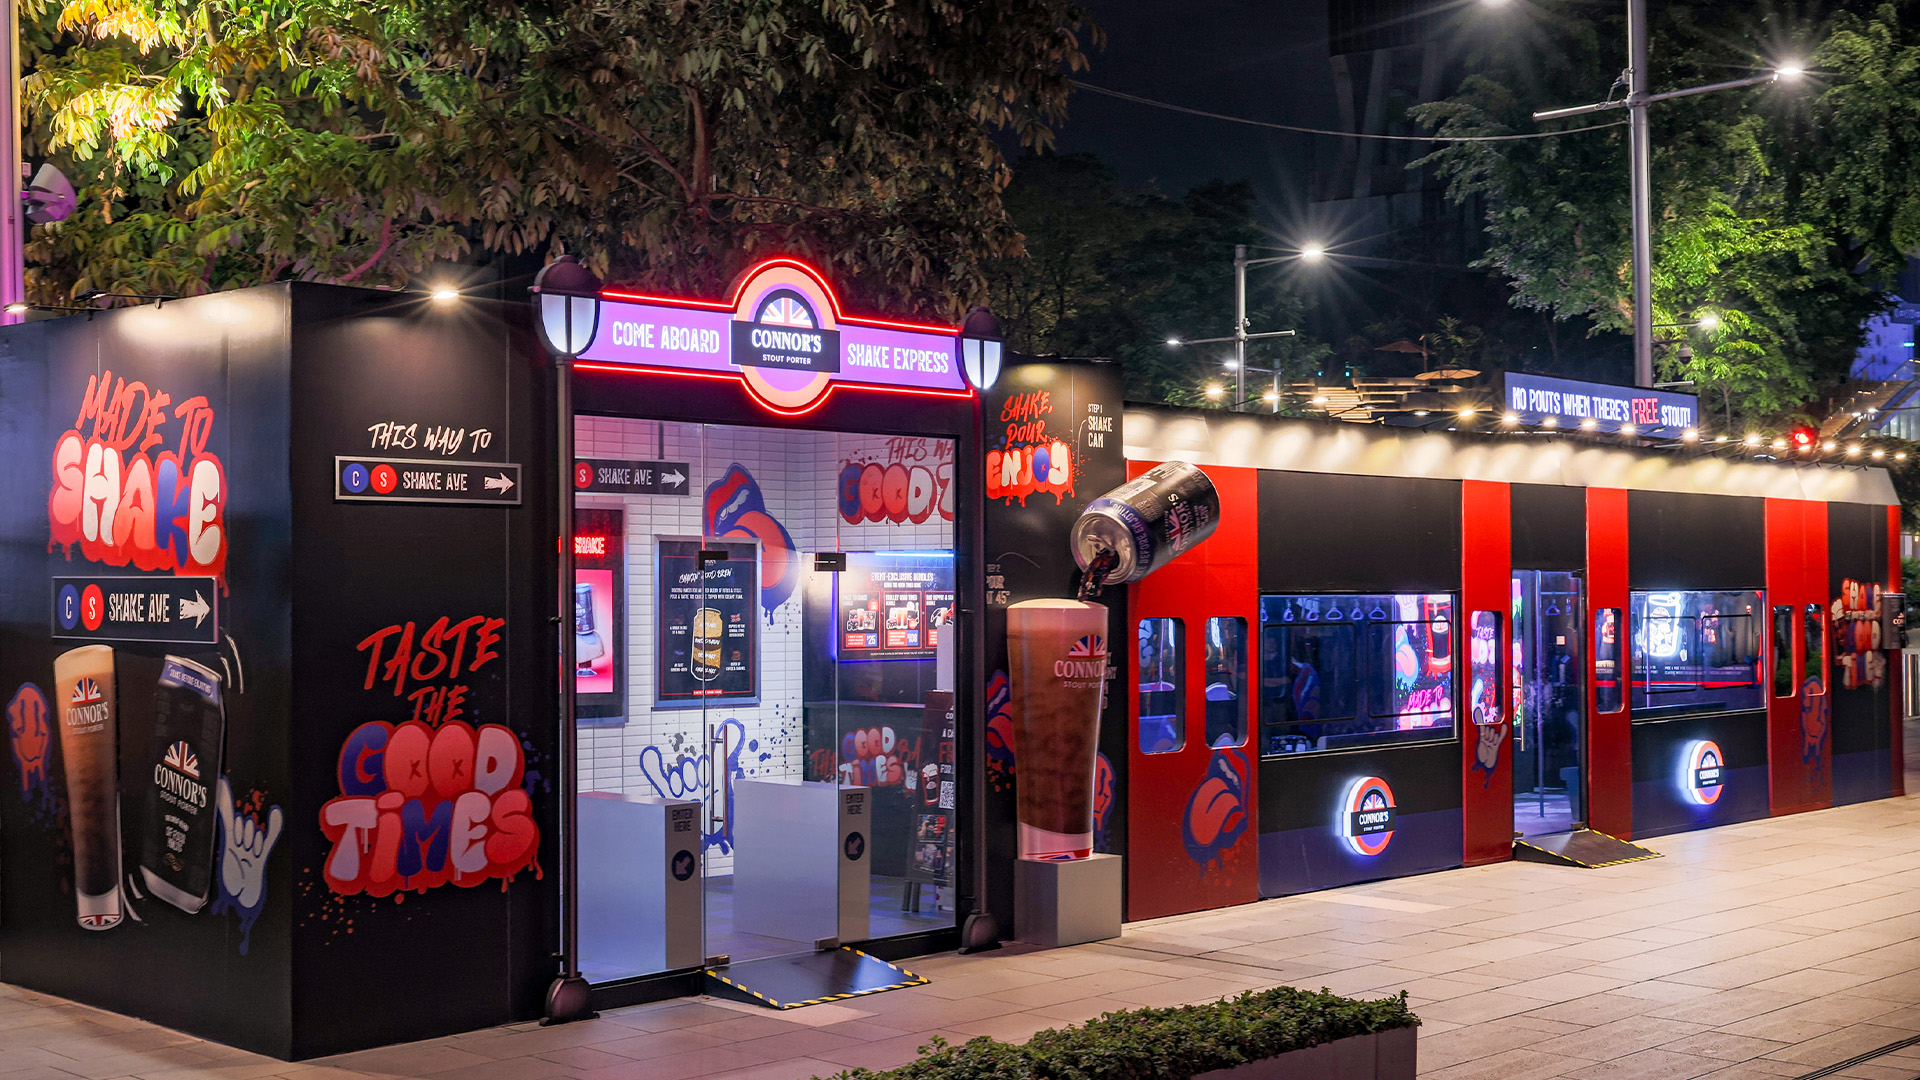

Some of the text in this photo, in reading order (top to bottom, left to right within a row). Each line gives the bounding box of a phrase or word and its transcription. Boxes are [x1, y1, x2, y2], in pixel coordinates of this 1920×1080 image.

[612, 320, 720, 354] COME ABOARD
[751, 328, 822, 354] CONNOR'S
[762, 354, 812, 366] STOUT PORTER
[847, 343, 949, 374] SHAKE EXPRESS
[75, 370, 215, 468] MADE TO
[1000, 389, 1054, 423] SHAKE,
[1088, 403, 1100, 413] STEP
[1512, 386, 1691, 428] NO POUTS WHEN THERE'S FREE STOUT!
[368, 421, 492, 455] THIS WAY TO
[1088, 415, 1113, 433] SHAKE
[885, 436, 927, 465] THIS
[1088, 432, 1104, 448] CAN
[353, 470, 468, 491] C S SHAKE AVE
[579, 467, 653, 486] S SHAKE AVE
[51, 433, 222, 570] SHAKE
[838, 463, 938, 525] GOOD
[65, 593, 170, 622] C S SHAKE AVE
[356, 615, 506, 697] TASTE
[66, 701, 109, 726] CONNOR'S
[407, 684, 470, 728] THE
[841, 726, 896, 761] GOOD
[340, 721, 523, 798] GOOD
[154, 763, 207, 809] CONNOR'S
[845, 793, 864, 804] ENTER
[672, 808, 694, 820] ENTER
[847, 804, 862, 815] HERE
[1359, 811, 1389, 826] CONNOR'S
[674, 820, 692, 832] HERE
